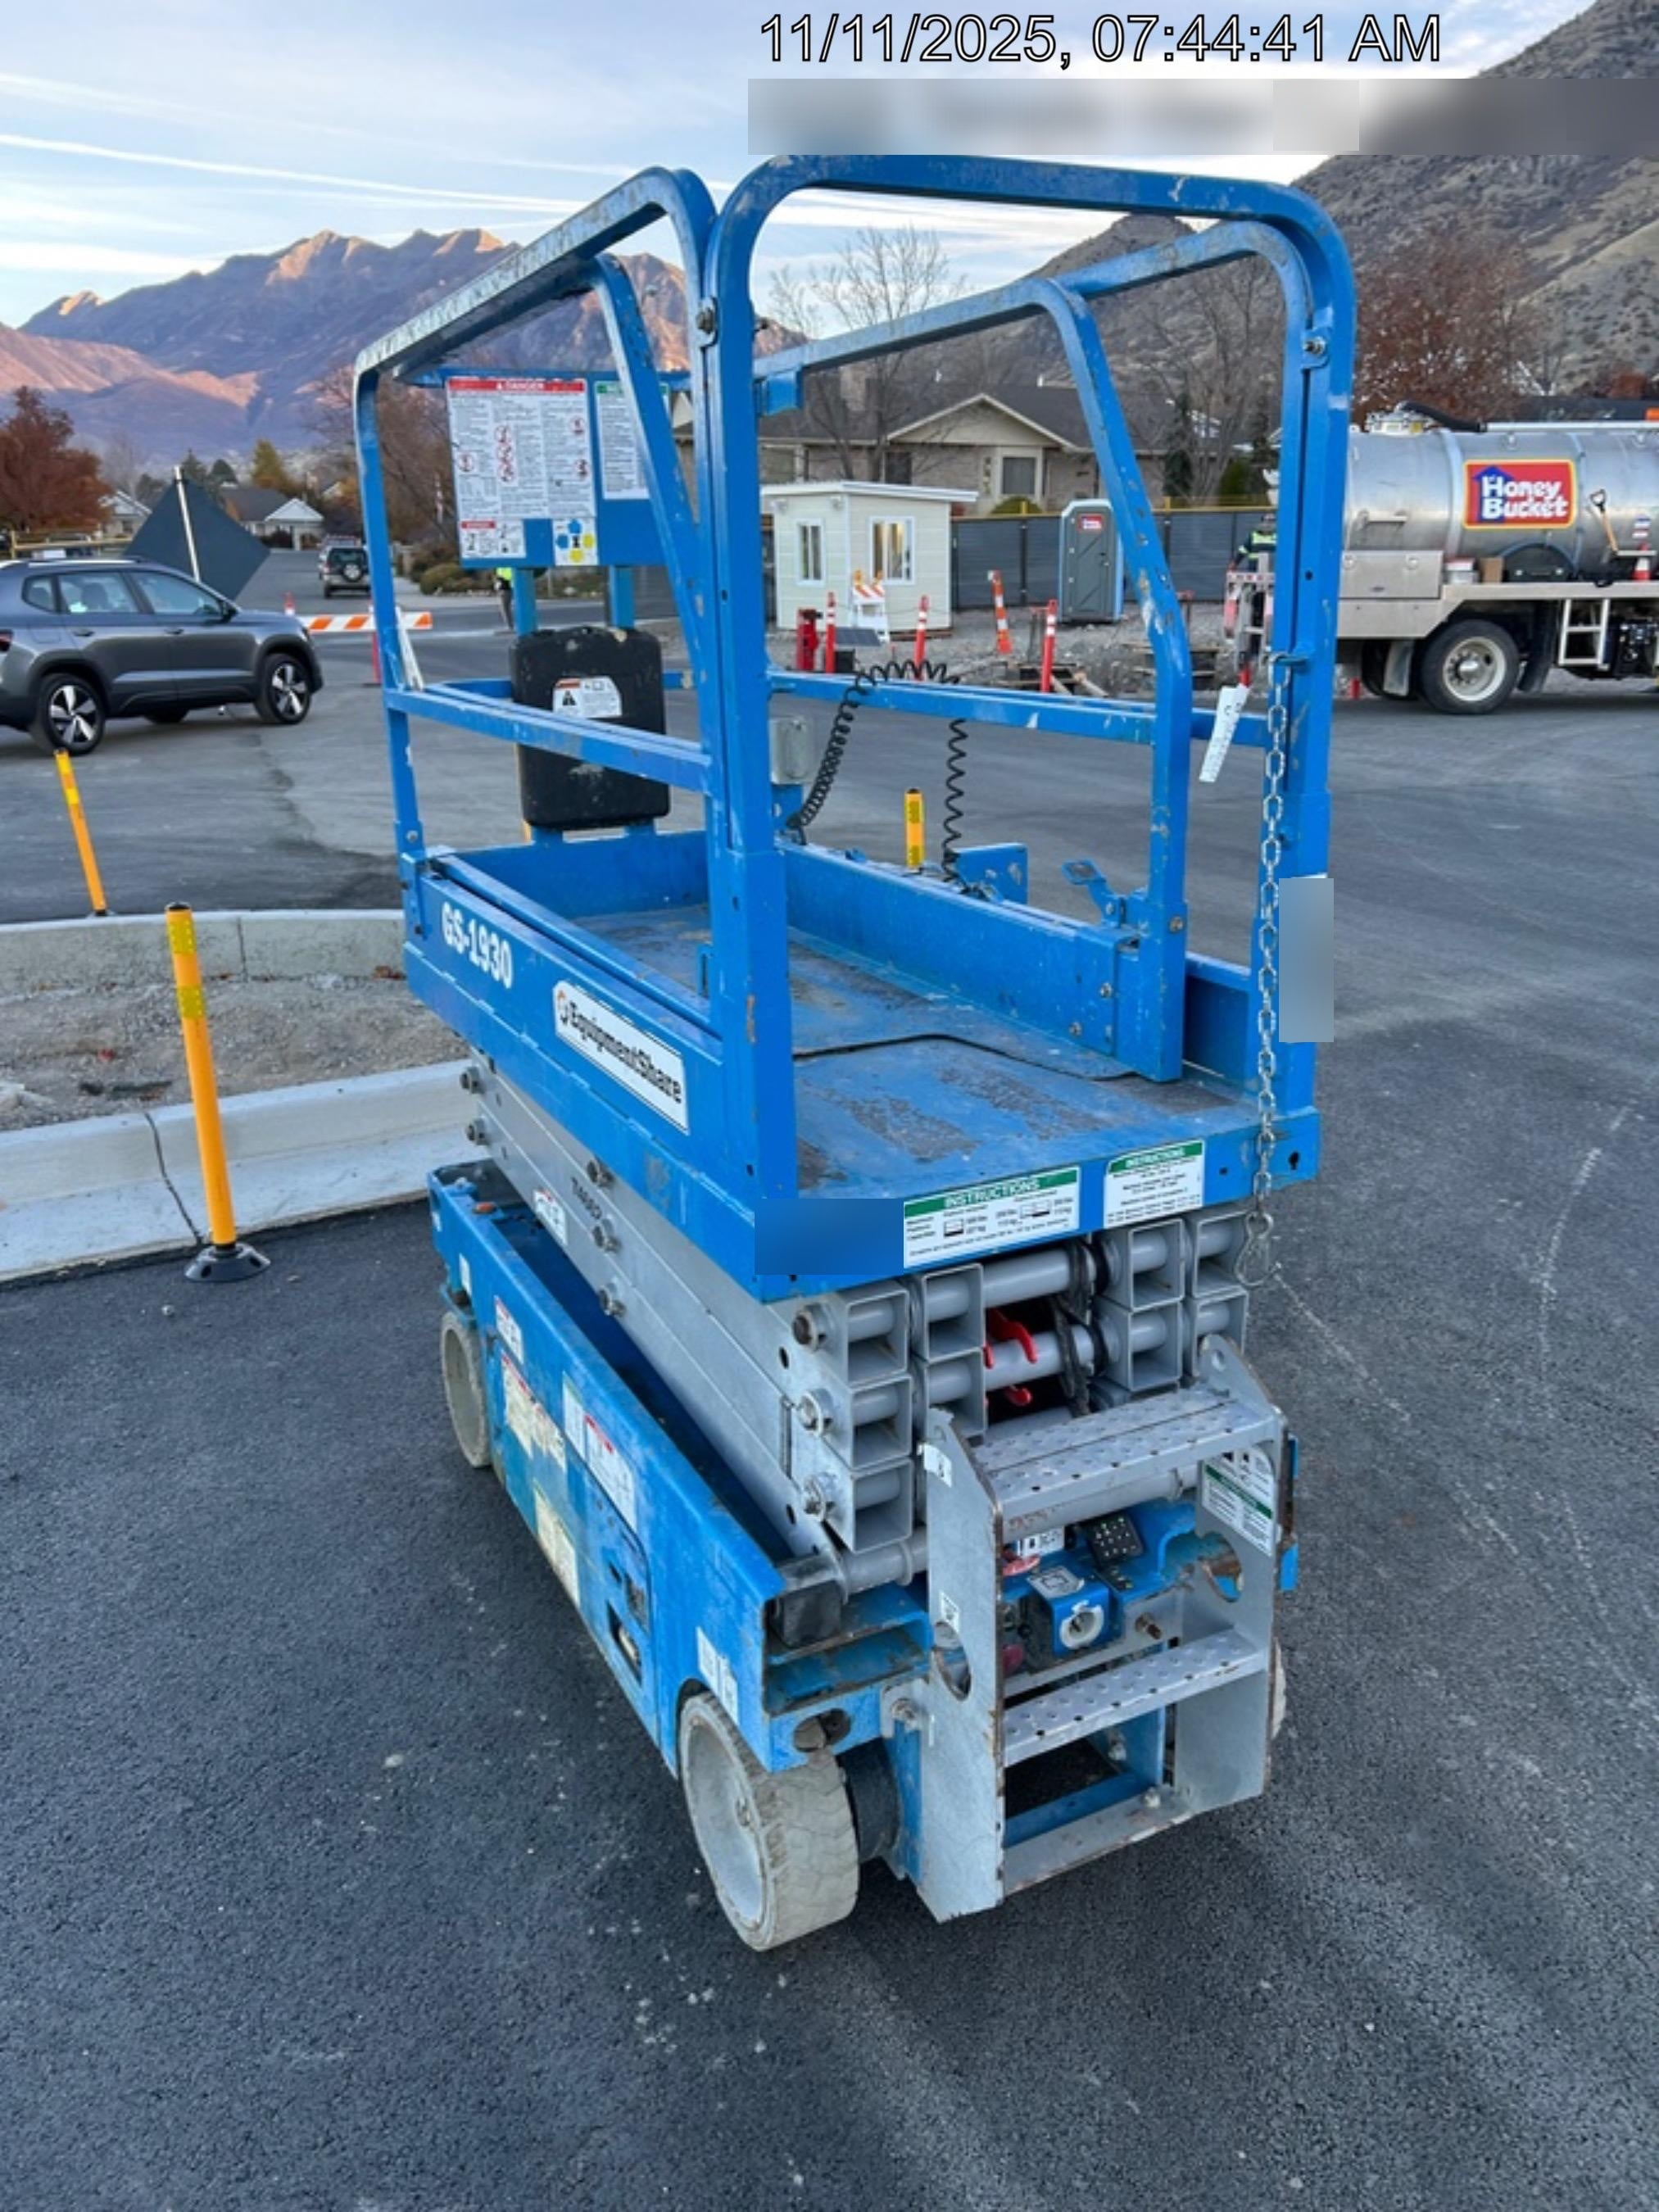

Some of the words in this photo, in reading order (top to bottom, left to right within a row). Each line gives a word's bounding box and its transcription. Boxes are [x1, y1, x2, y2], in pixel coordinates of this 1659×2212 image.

[1481, 475, 1562, 501] Honey
[1481, 496, 1569, 519] Bucket
[442, 901, 513, 989] GS-1930
[569, 1000, 682, 1104] EquipmentShare
[944, 1176, 1040, 1210] INSTRUCTIONS
